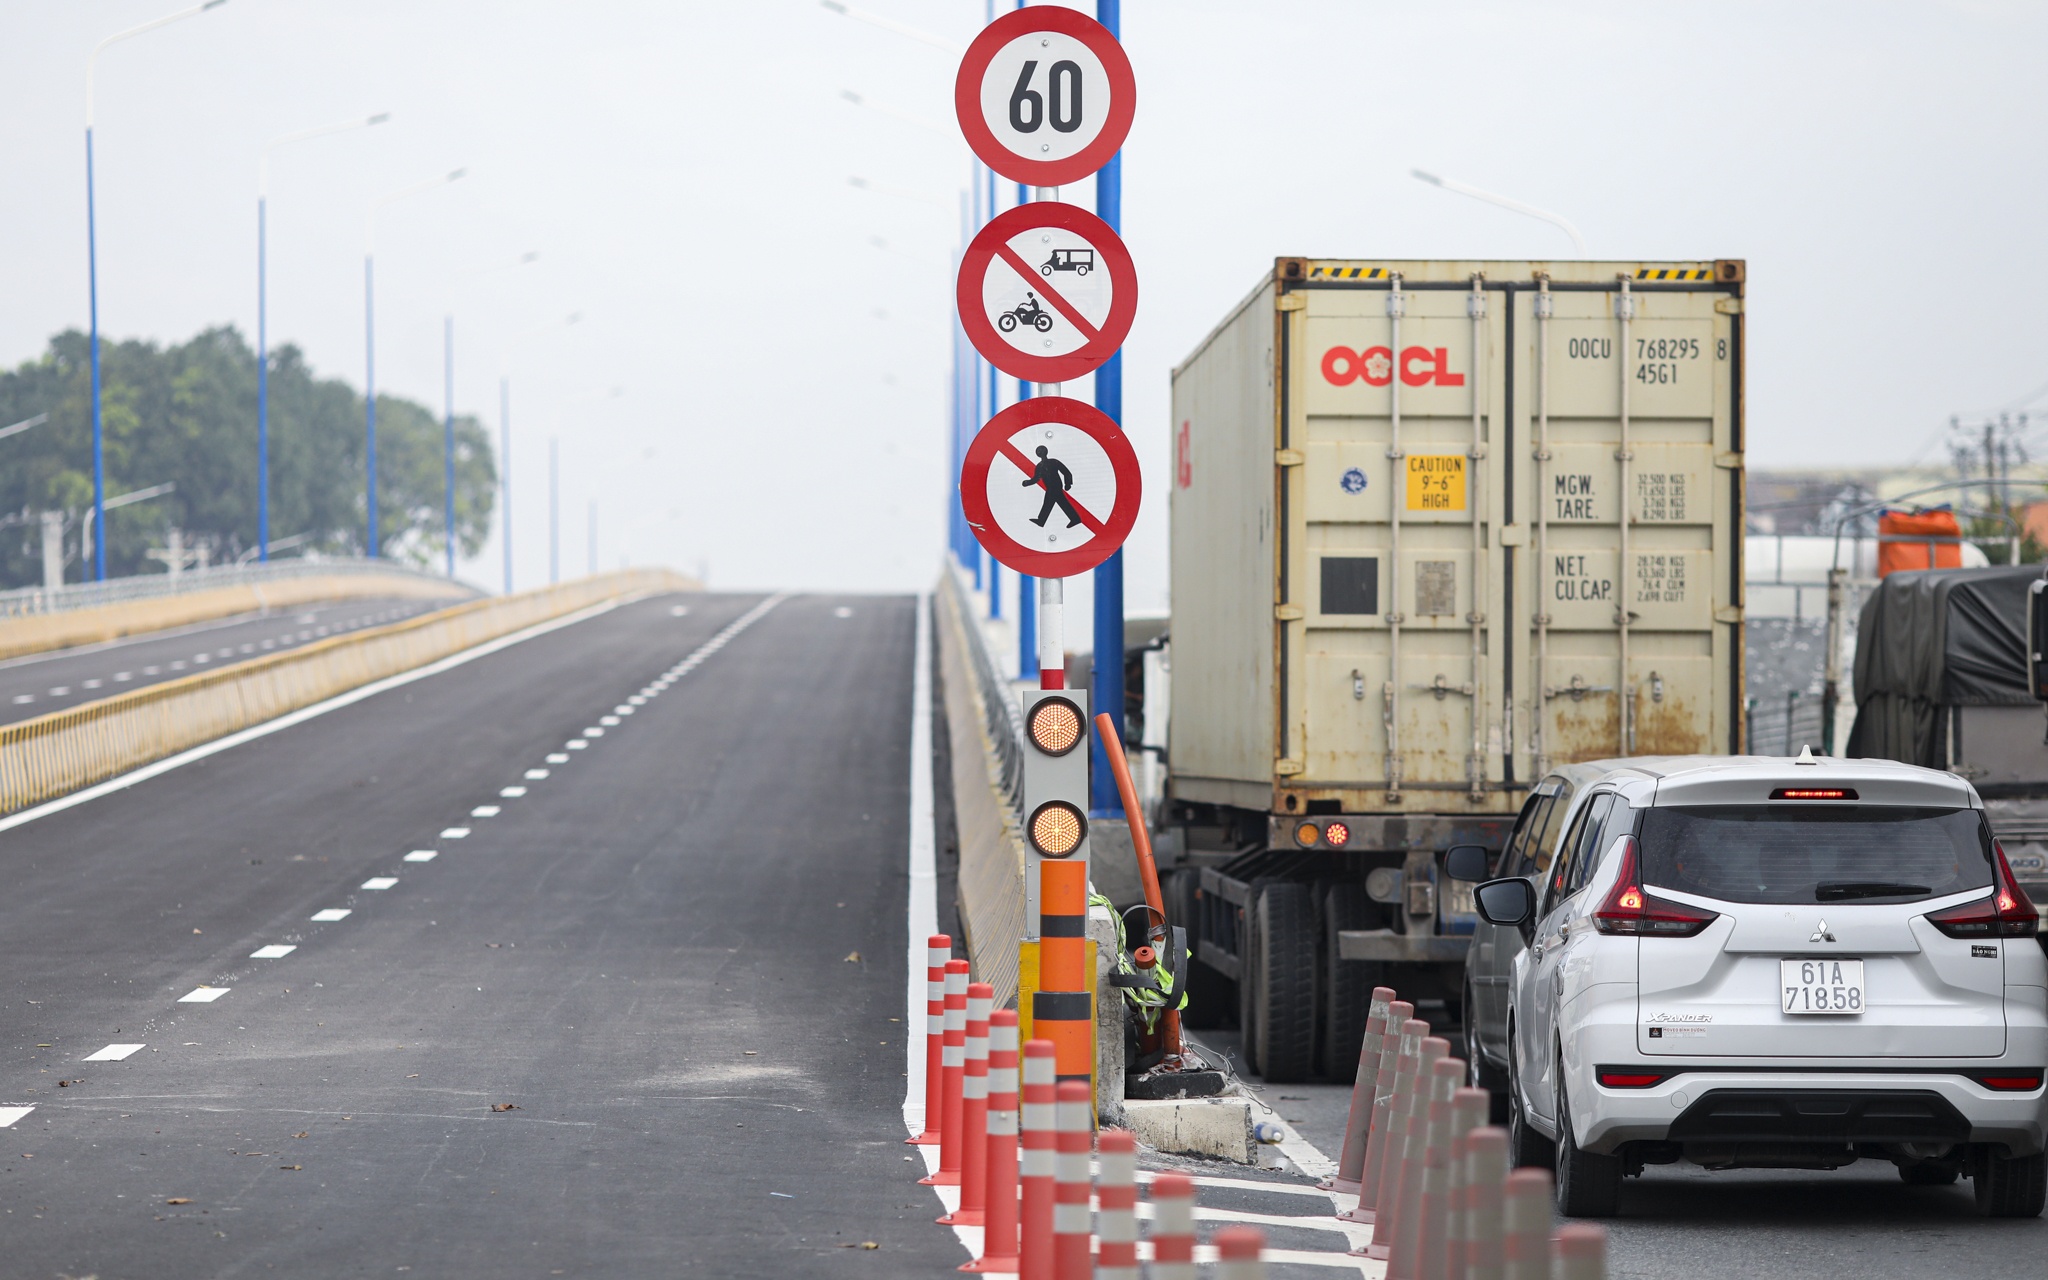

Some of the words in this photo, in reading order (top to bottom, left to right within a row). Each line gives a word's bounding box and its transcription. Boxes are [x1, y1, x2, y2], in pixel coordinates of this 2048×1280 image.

[1009, 60, 1083, 134] 60
[1636, 339, 1699, 360] 768295
[1716, 339, 1727, 361] 8
[1320, 345, 1465, 387] OOCL
[1636, 363, 1677, 384] 45G1
[1410, 457, 1461, 472] CAUTION
[1555, 475, 1596, 495] MGW.
[1422, 493, 1449, 508] HIGH
[1556, 498, 1599, 519] TARE.
[1555, 556, 1588, 577] NET.
[1801, 962, 1843, 984] 61A
[1786, 987, 1861, 1010] 718.58
[1645, 1012, 1713, 1023] XPANDER
